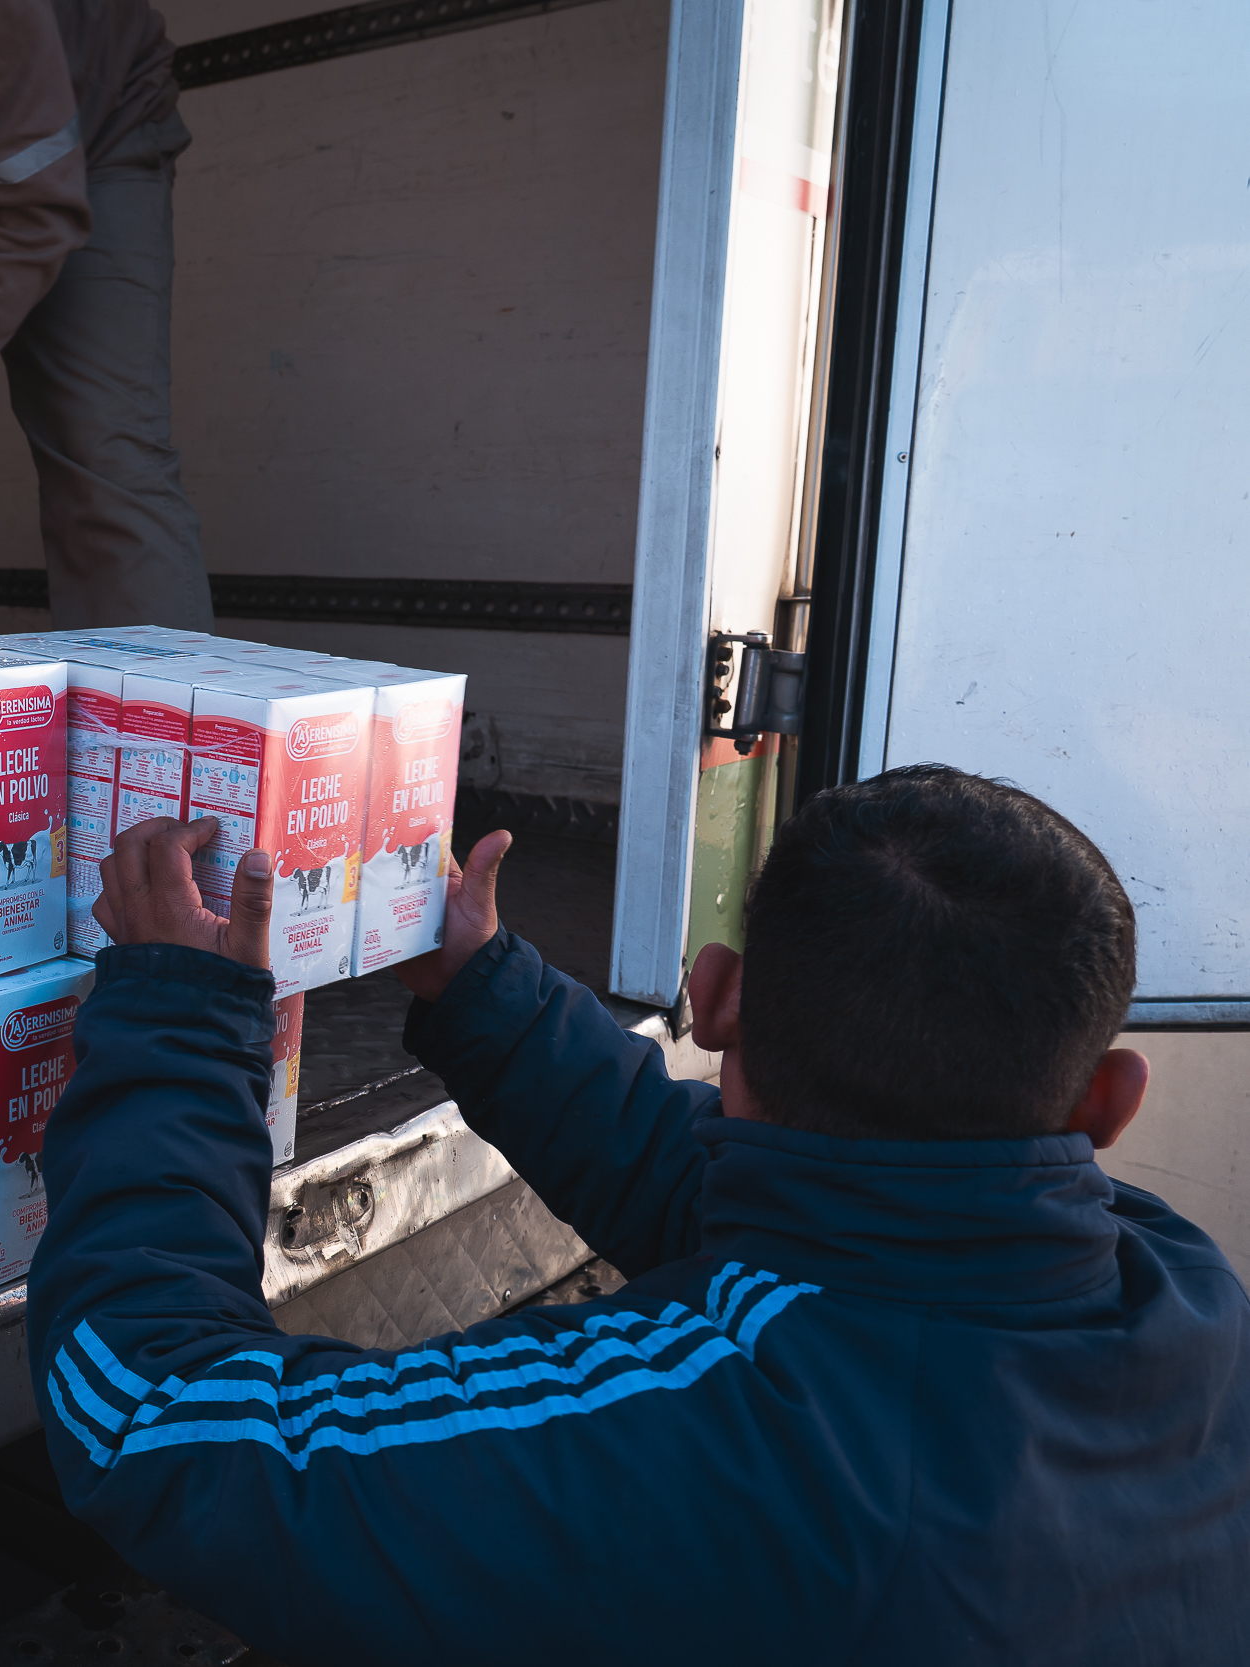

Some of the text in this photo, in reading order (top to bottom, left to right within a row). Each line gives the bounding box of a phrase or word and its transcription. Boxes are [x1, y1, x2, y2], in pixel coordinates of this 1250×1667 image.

[404, 756, 440, 784] LECHE
[9, 773, 47, 804] POLVO
[301, 774, 343, 804] LECHE
[287, 800, 350, 836] EN POLVO
[4, 911, 32, 928] ANIMAL
[289, 923, 330, 944] BIENESTAR
[294, 936, 323, 954] ANIMAL
[22, 1055, 66, 1091] LECHE
[9, 1094, 27, 1123] EN
